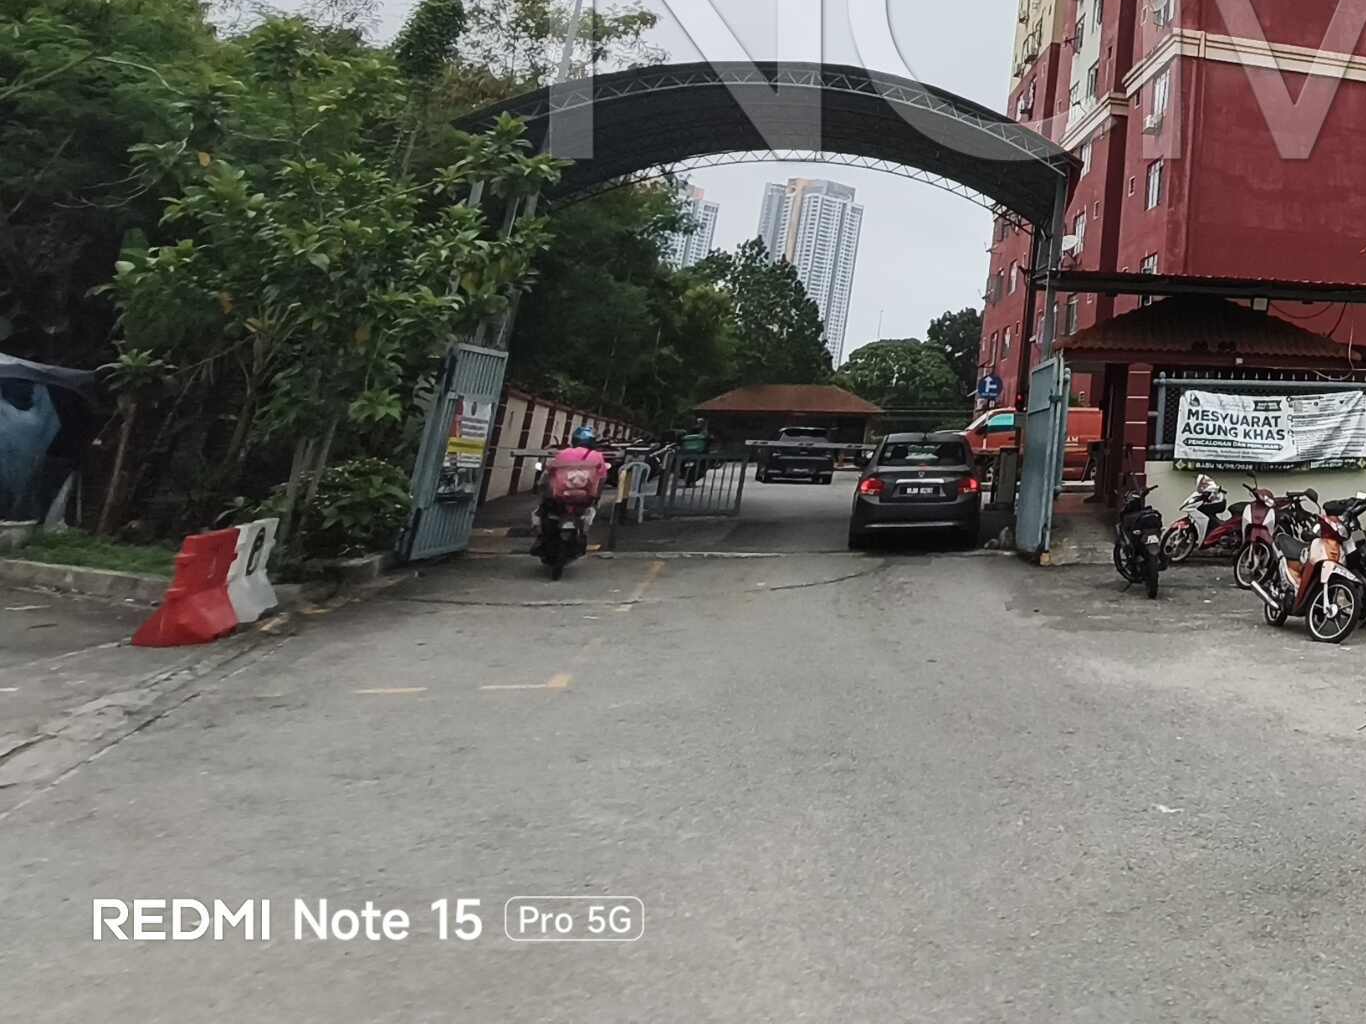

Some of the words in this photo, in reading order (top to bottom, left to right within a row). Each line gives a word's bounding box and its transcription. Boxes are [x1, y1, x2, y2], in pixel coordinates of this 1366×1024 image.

[1187, 408, 1281, 428] MESYUARAT
[1181, 422, 1238, 438] AGUNG
[1243, 428, 1285, 441] KHAS
